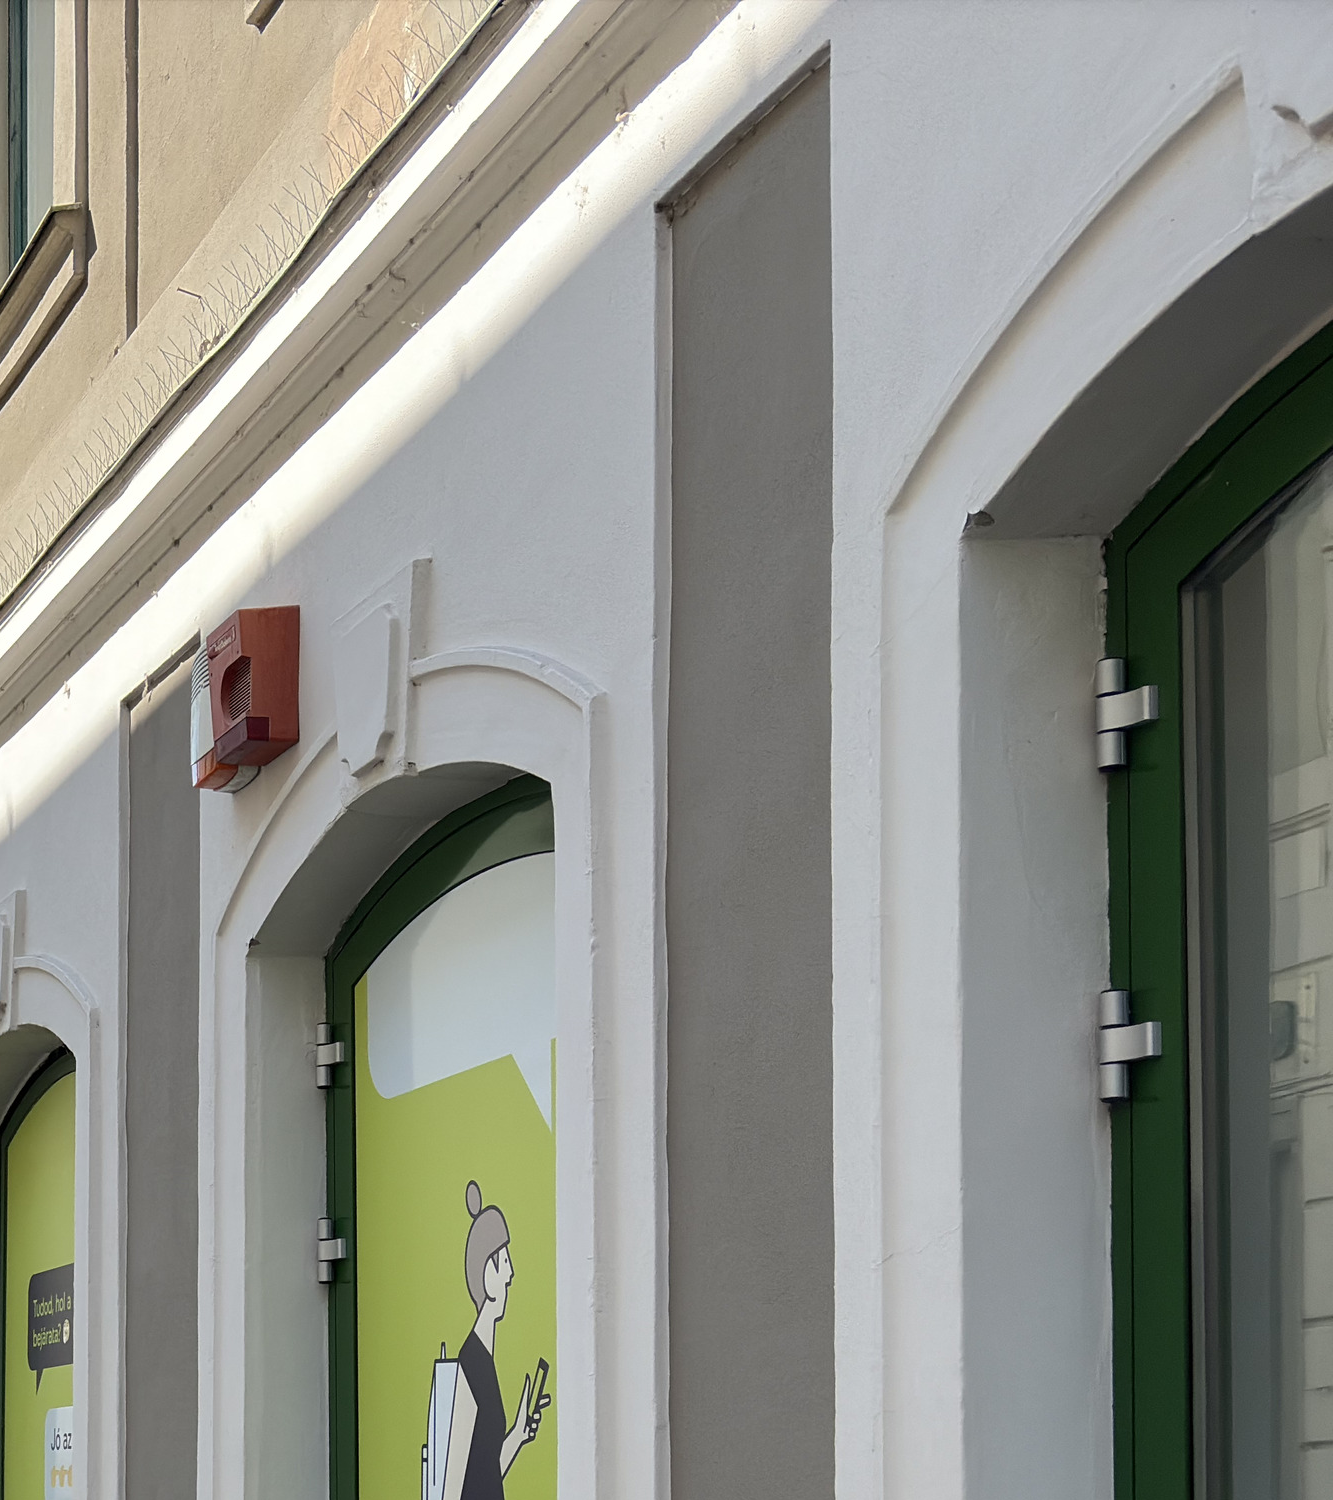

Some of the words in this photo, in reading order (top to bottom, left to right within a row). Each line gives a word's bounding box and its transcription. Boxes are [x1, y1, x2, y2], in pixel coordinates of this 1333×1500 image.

[33, 1294, 54, 1318] Tudod,
[55, 1291, 66, 1313] hol
[66, 1295, 72, 1310] a
[33, 1322, 62, 1351] bejárata?
[50, 1427, 61, 1451] Jó
[63, 1432, 72, 1450] az
